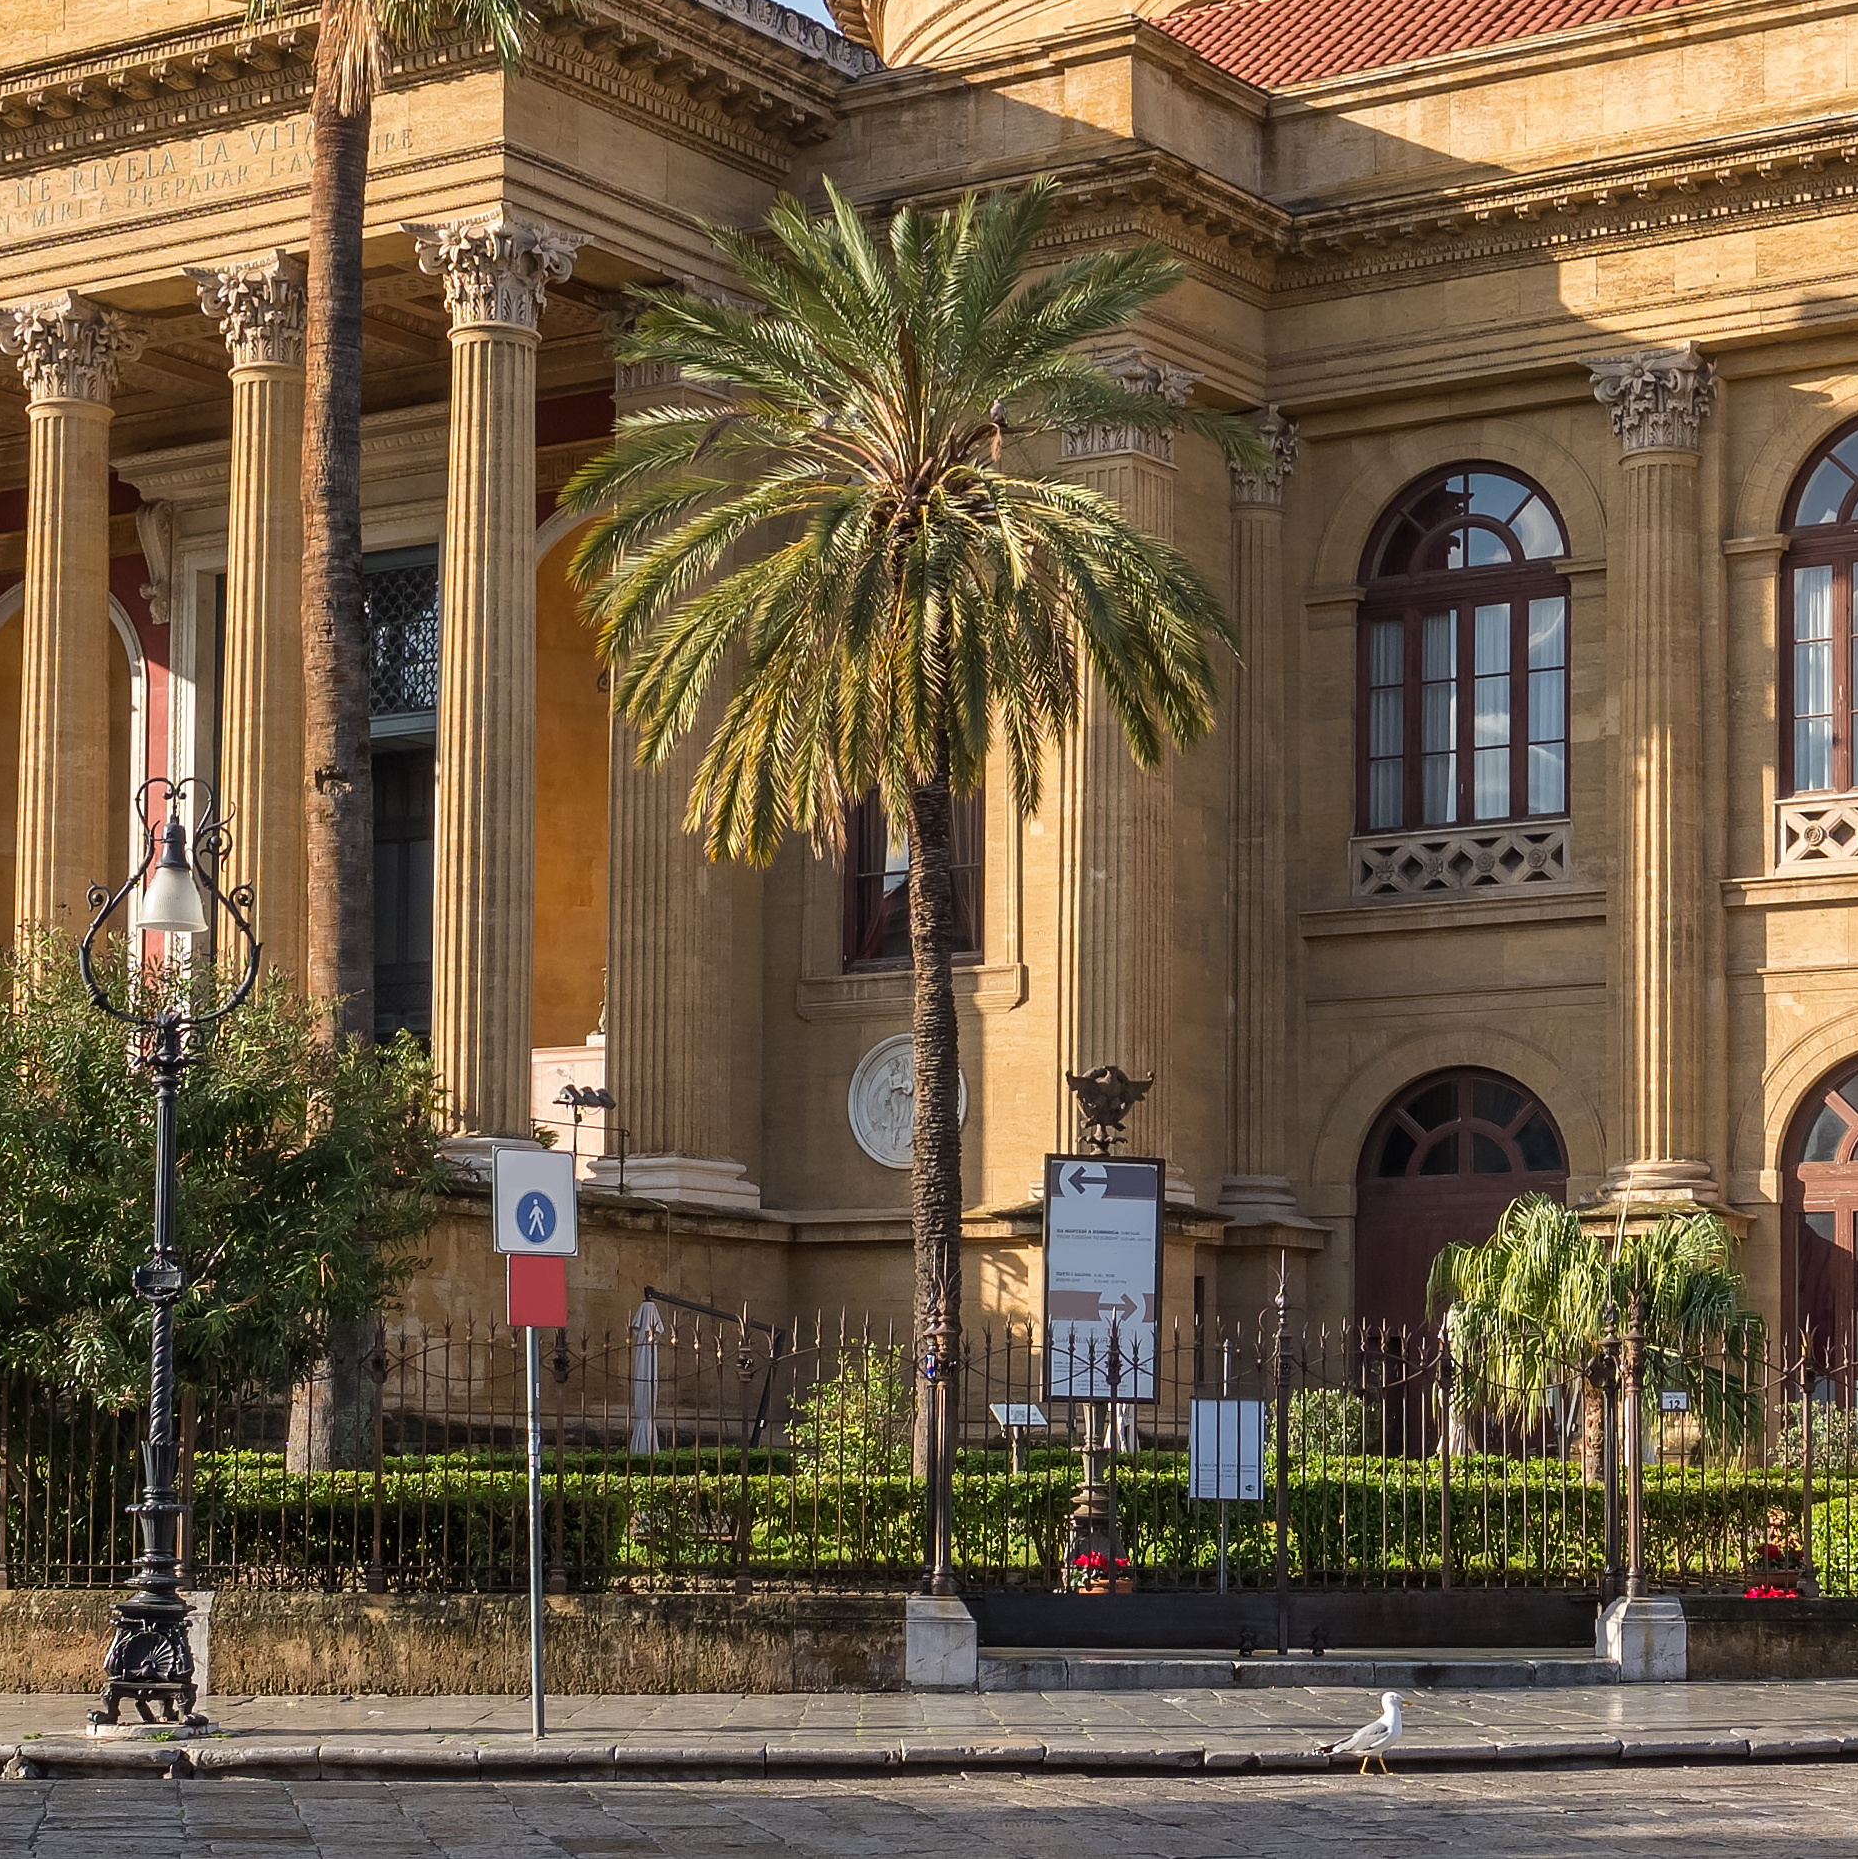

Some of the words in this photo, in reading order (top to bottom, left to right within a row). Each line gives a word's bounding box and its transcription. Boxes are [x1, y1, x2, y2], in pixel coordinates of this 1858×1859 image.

[15, 177, 52, 208] NE
[70, 150, 178, 195] RIVELA
[197, 138, 231, 168] LA
[31, 198, 83, 228] MIRI
[99, 195, 111, 214] A
[126, 164, 251, 208] PREPARAR
[1669, 1399, 1681, 1410] 12
